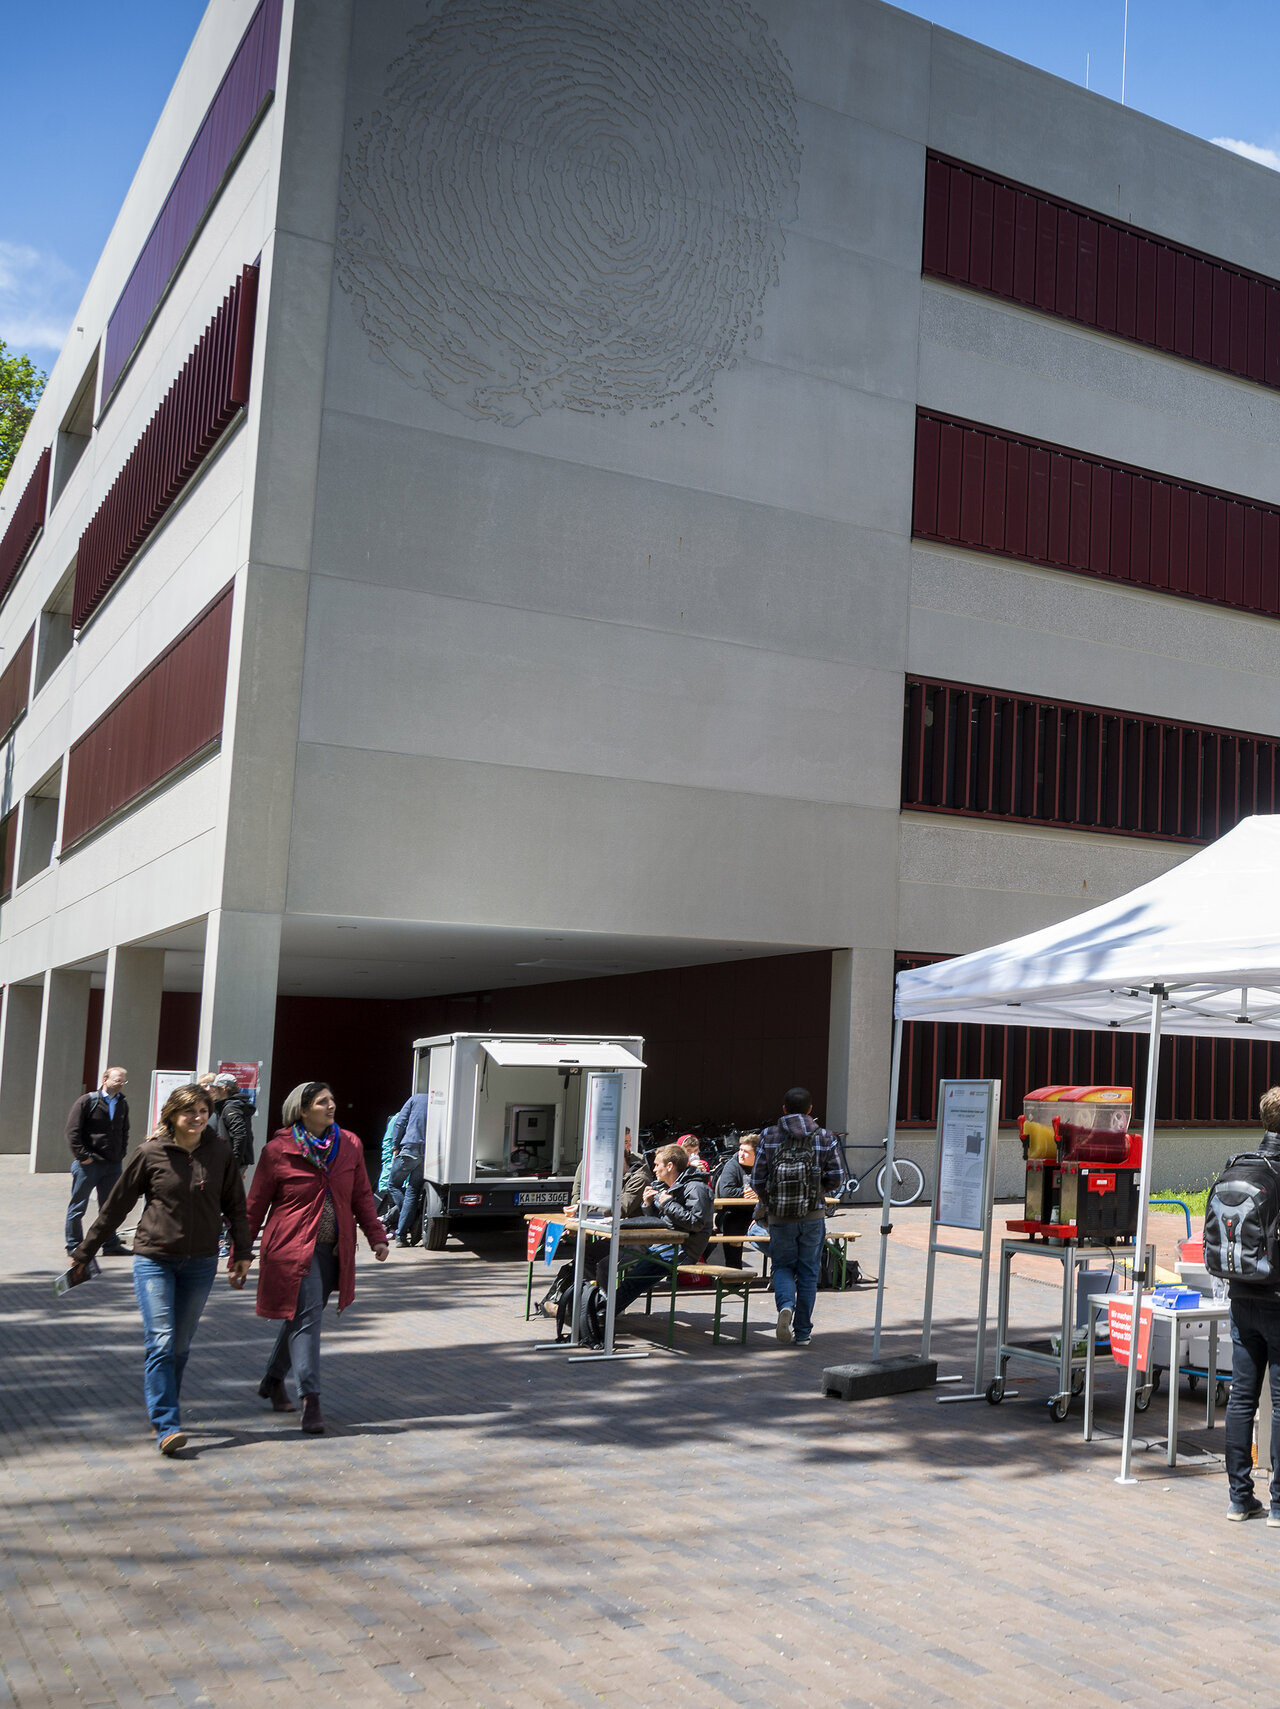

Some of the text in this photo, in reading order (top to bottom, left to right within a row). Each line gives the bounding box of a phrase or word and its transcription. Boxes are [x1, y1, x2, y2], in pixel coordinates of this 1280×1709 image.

[519, 1193, 568, 1203] KA HS 306E
